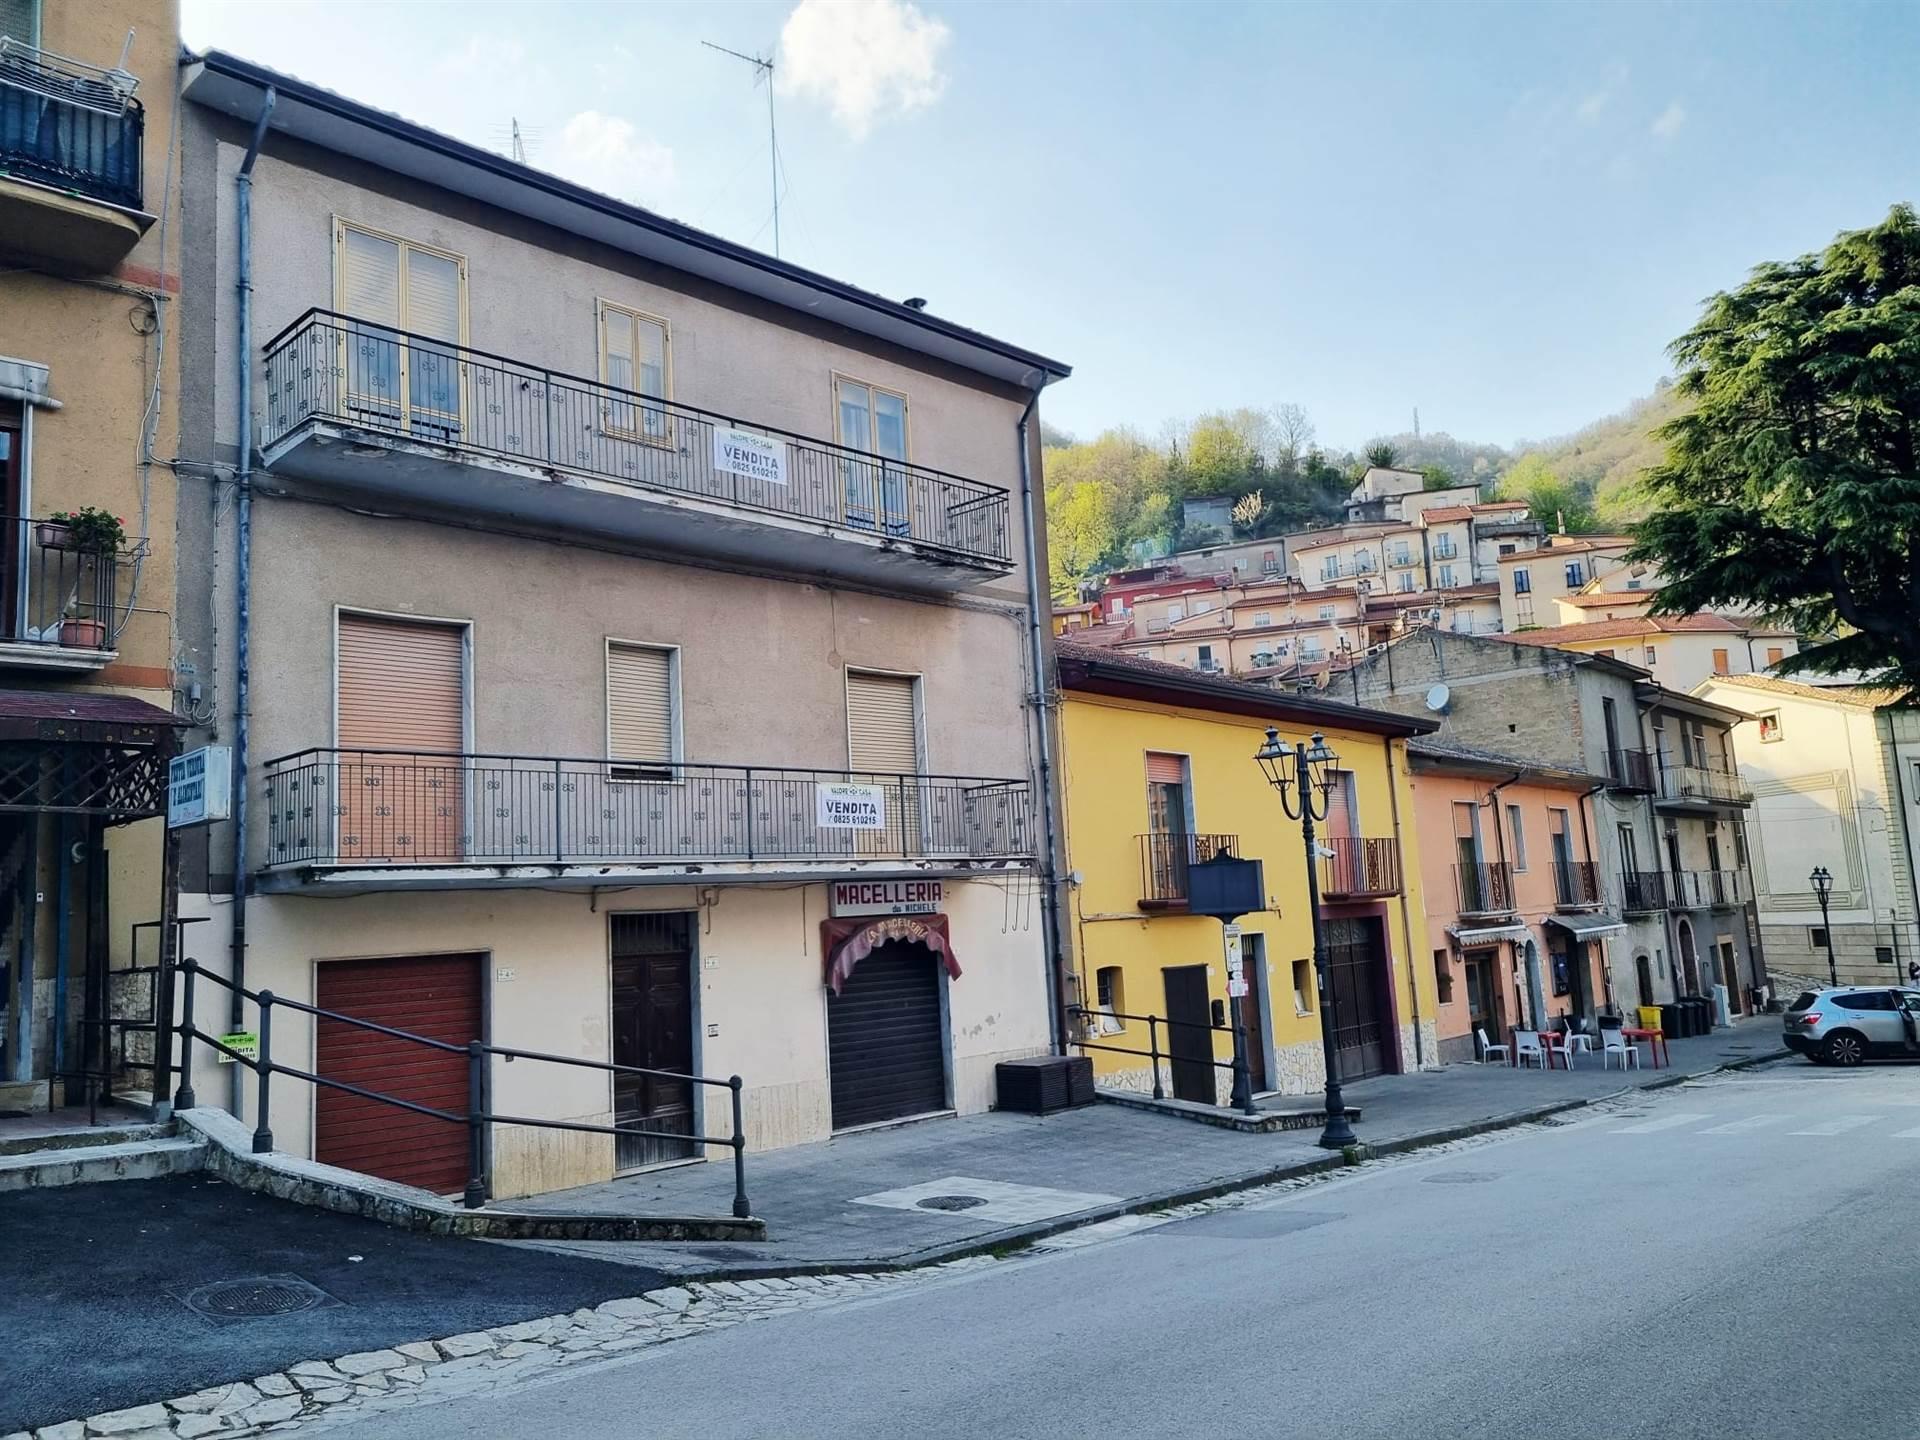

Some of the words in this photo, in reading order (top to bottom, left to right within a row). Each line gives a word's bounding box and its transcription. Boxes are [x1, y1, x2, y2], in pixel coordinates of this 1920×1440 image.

[724, 446, 778, 469] VENDITA
[732, 460, 750, 472] 0825
[752, 466, 778, 479] 610215
[826, 801, 877, 815] VENDITA
[833, 814, 850, 824] 0825
[852, 815, 877, 825] 610215
[836, 882, 942, 905] MACELLERIA
